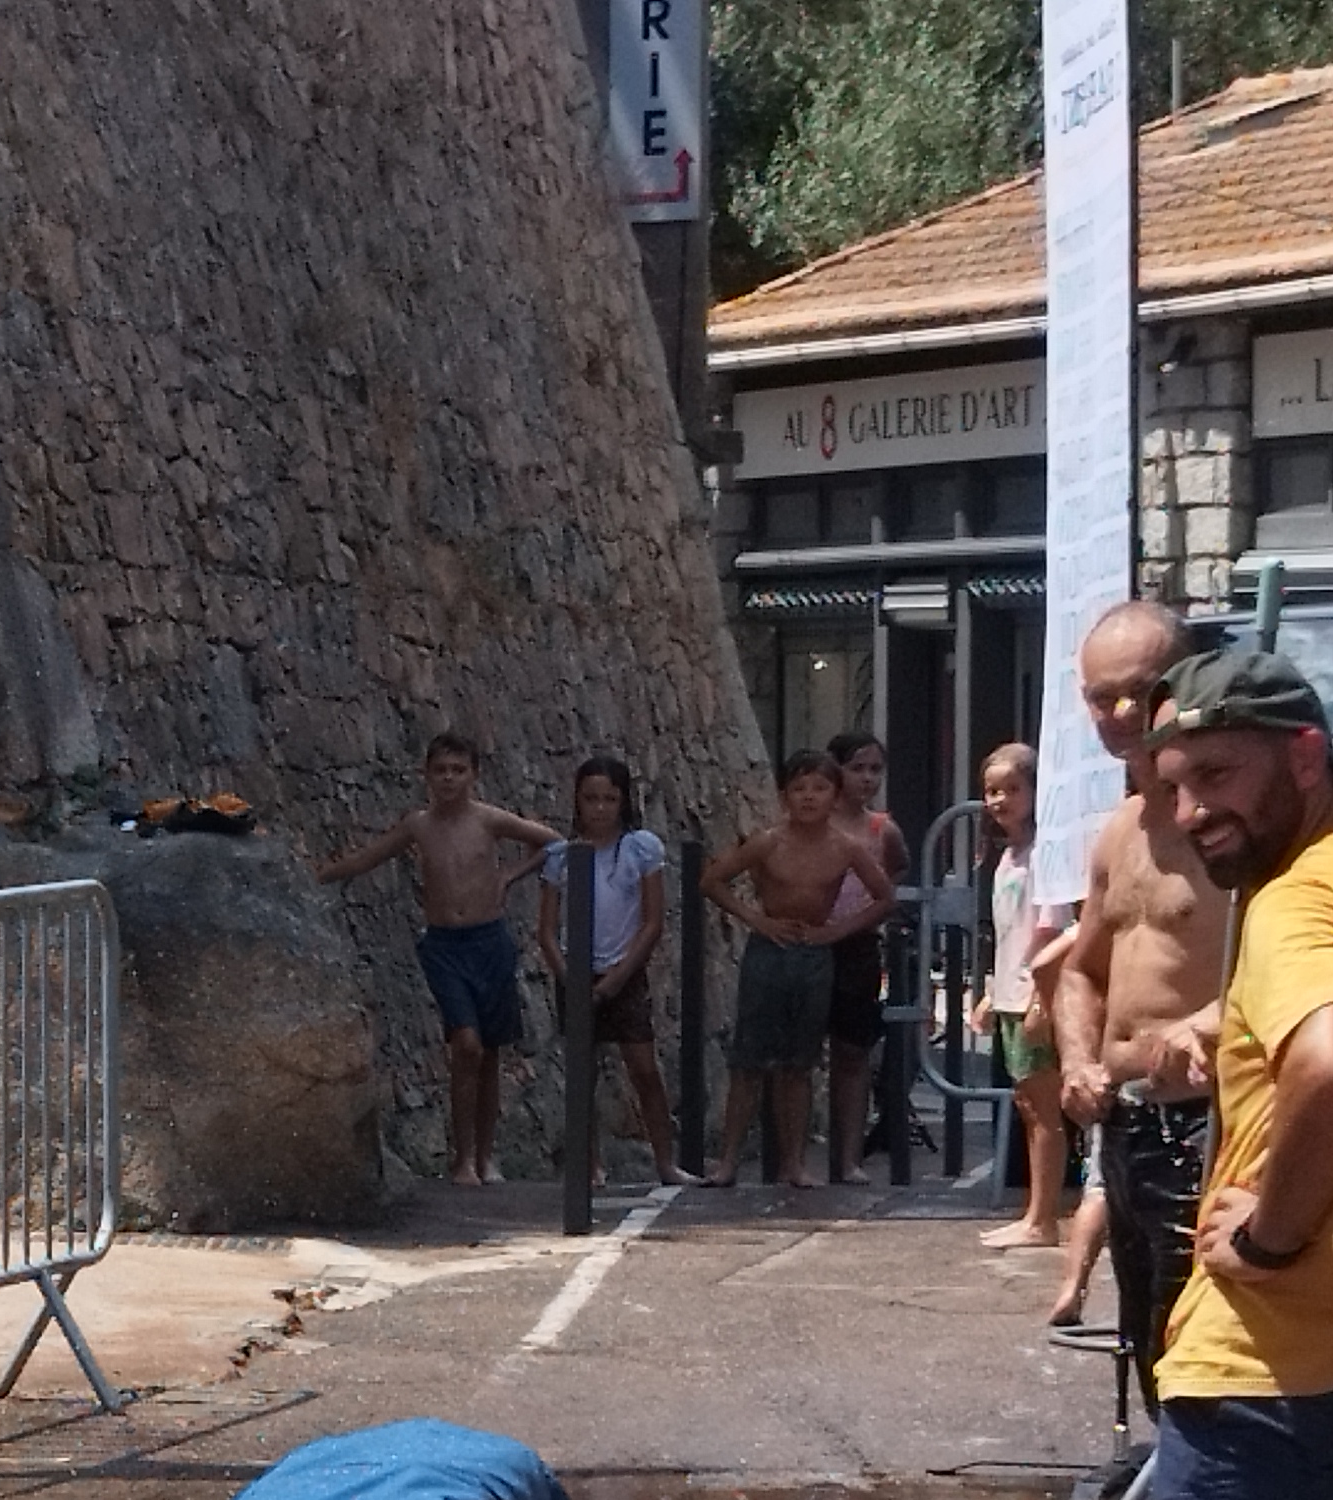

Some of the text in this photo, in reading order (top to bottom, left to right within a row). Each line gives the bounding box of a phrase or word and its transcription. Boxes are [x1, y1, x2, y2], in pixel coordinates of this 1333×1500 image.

[785, 384, 1035, 460] AU 8 GALERIE D'ART
